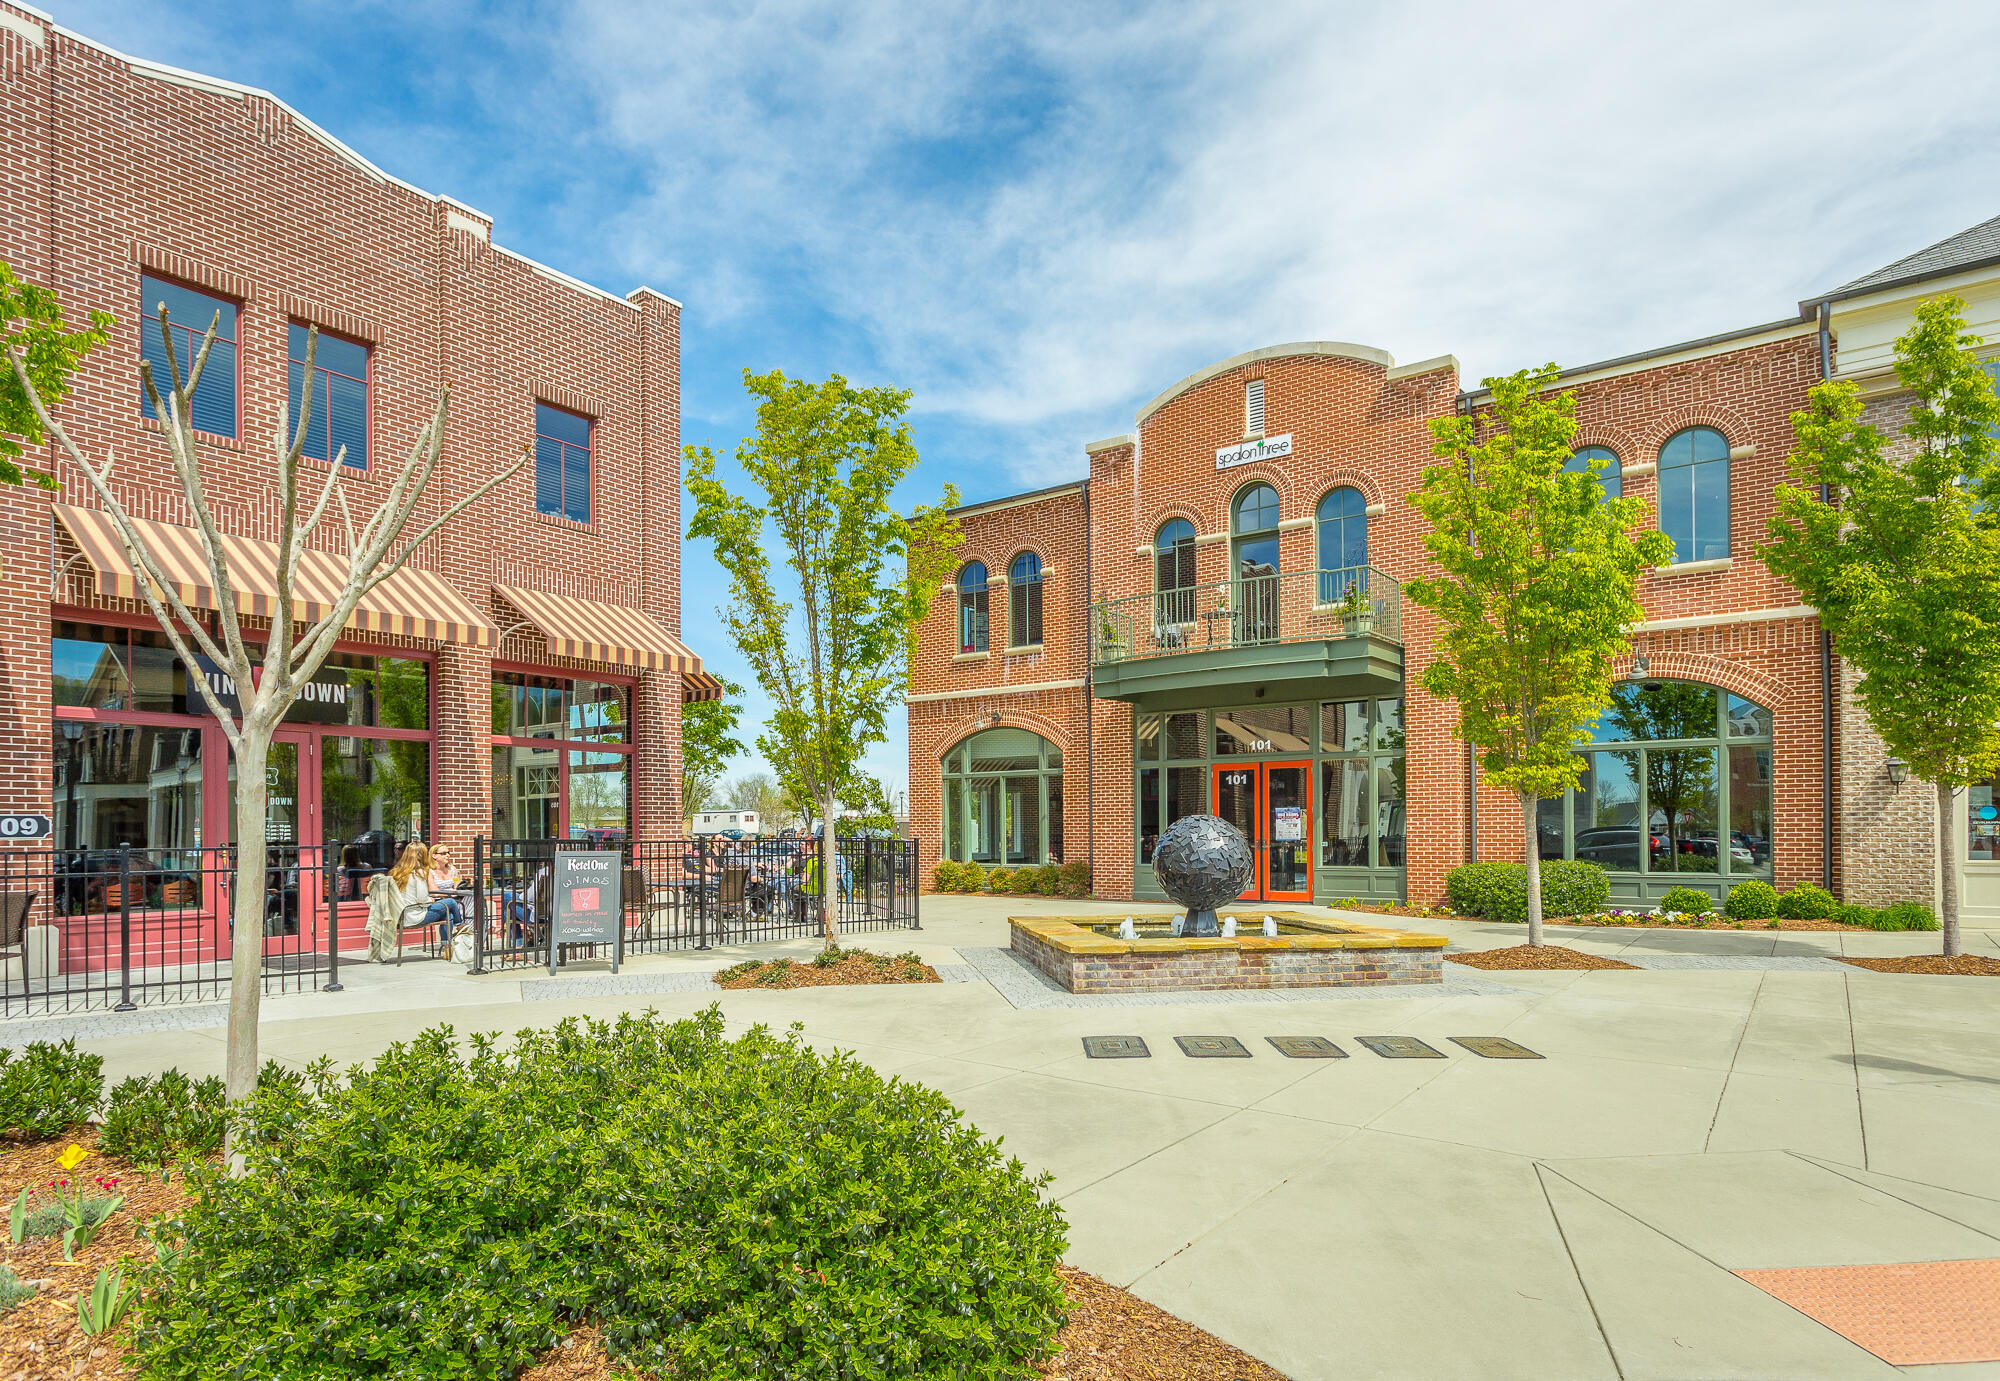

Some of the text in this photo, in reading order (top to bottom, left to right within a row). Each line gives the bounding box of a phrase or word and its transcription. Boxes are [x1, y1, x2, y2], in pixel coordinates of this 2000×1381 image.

[1249, 740, 1271, 750] 101
[1225, 774, 1247, 784] 101
[269, 797, 292, 805] DOWN
